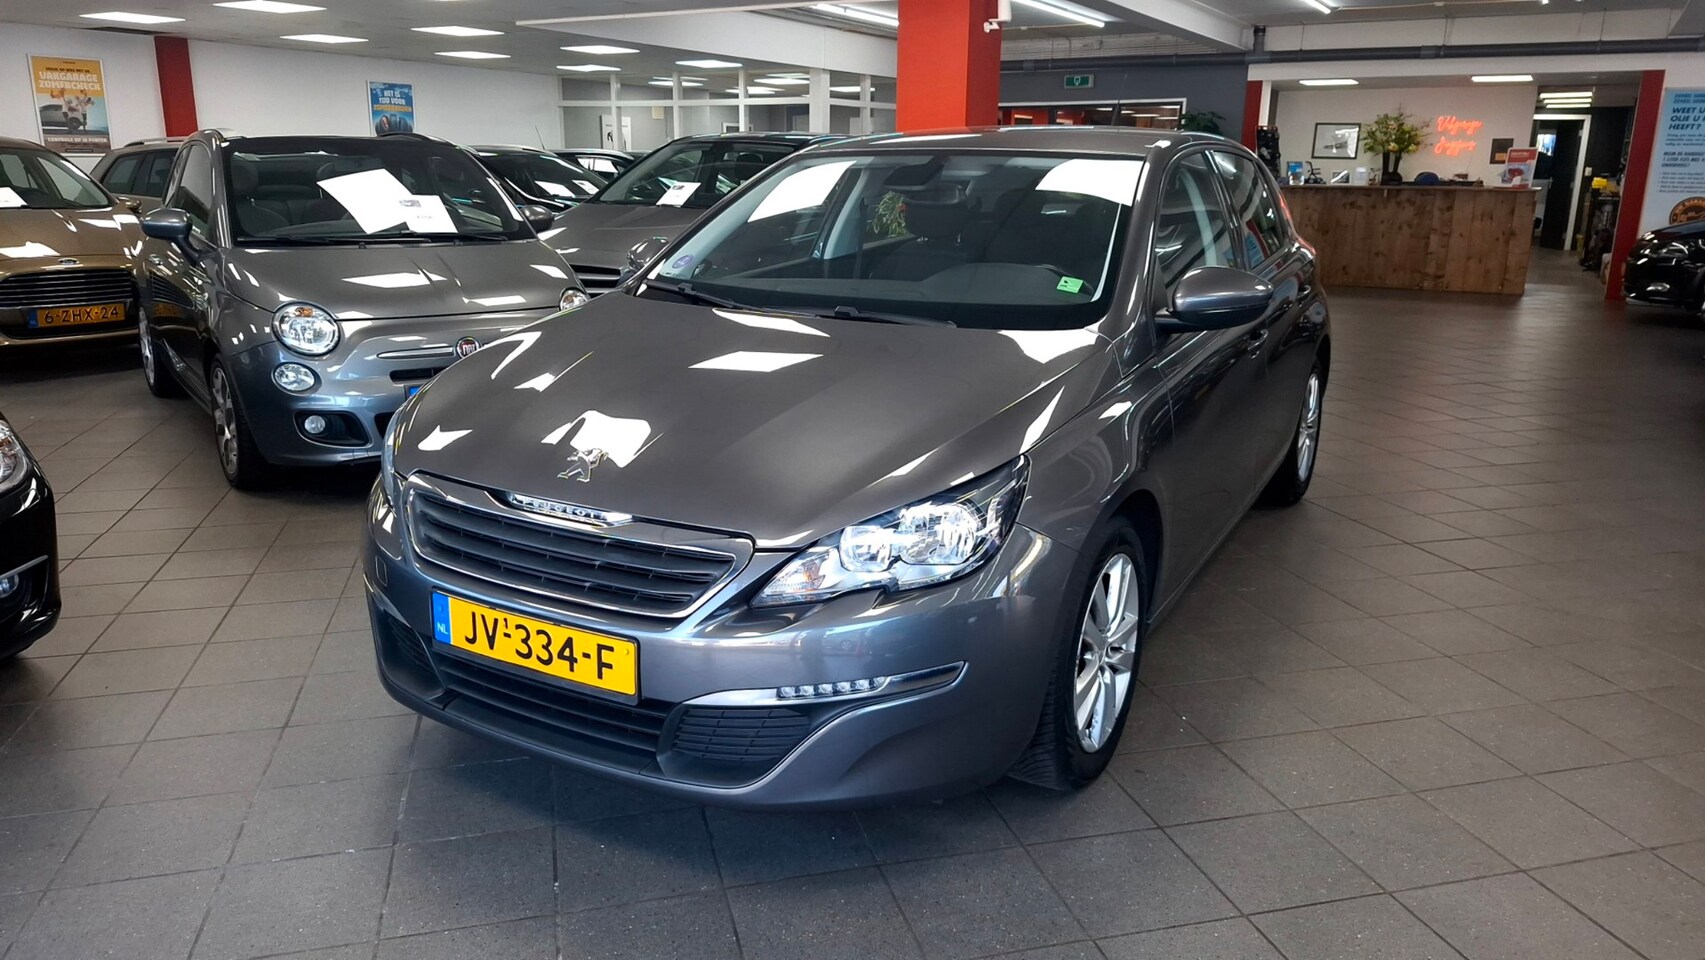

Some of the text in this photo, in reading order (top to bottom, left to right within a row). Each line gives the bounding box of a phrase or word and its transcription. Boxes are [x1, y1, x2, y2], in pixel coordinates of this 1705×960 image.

[39, 71, 98, 82] VAKGARAGE
[38, 80, 101, 91] ZOMERCHECK
[391, 97, 406, 105] VOOR
[1672, 106, 1697, 114] WEET
[44, 307, 118, 324] 6-ZHX-24
[462, 344, 476, 355] FIAT
[518, 496, 601, 519] PEUGEOT
[437, 621, 449, 635] NL
